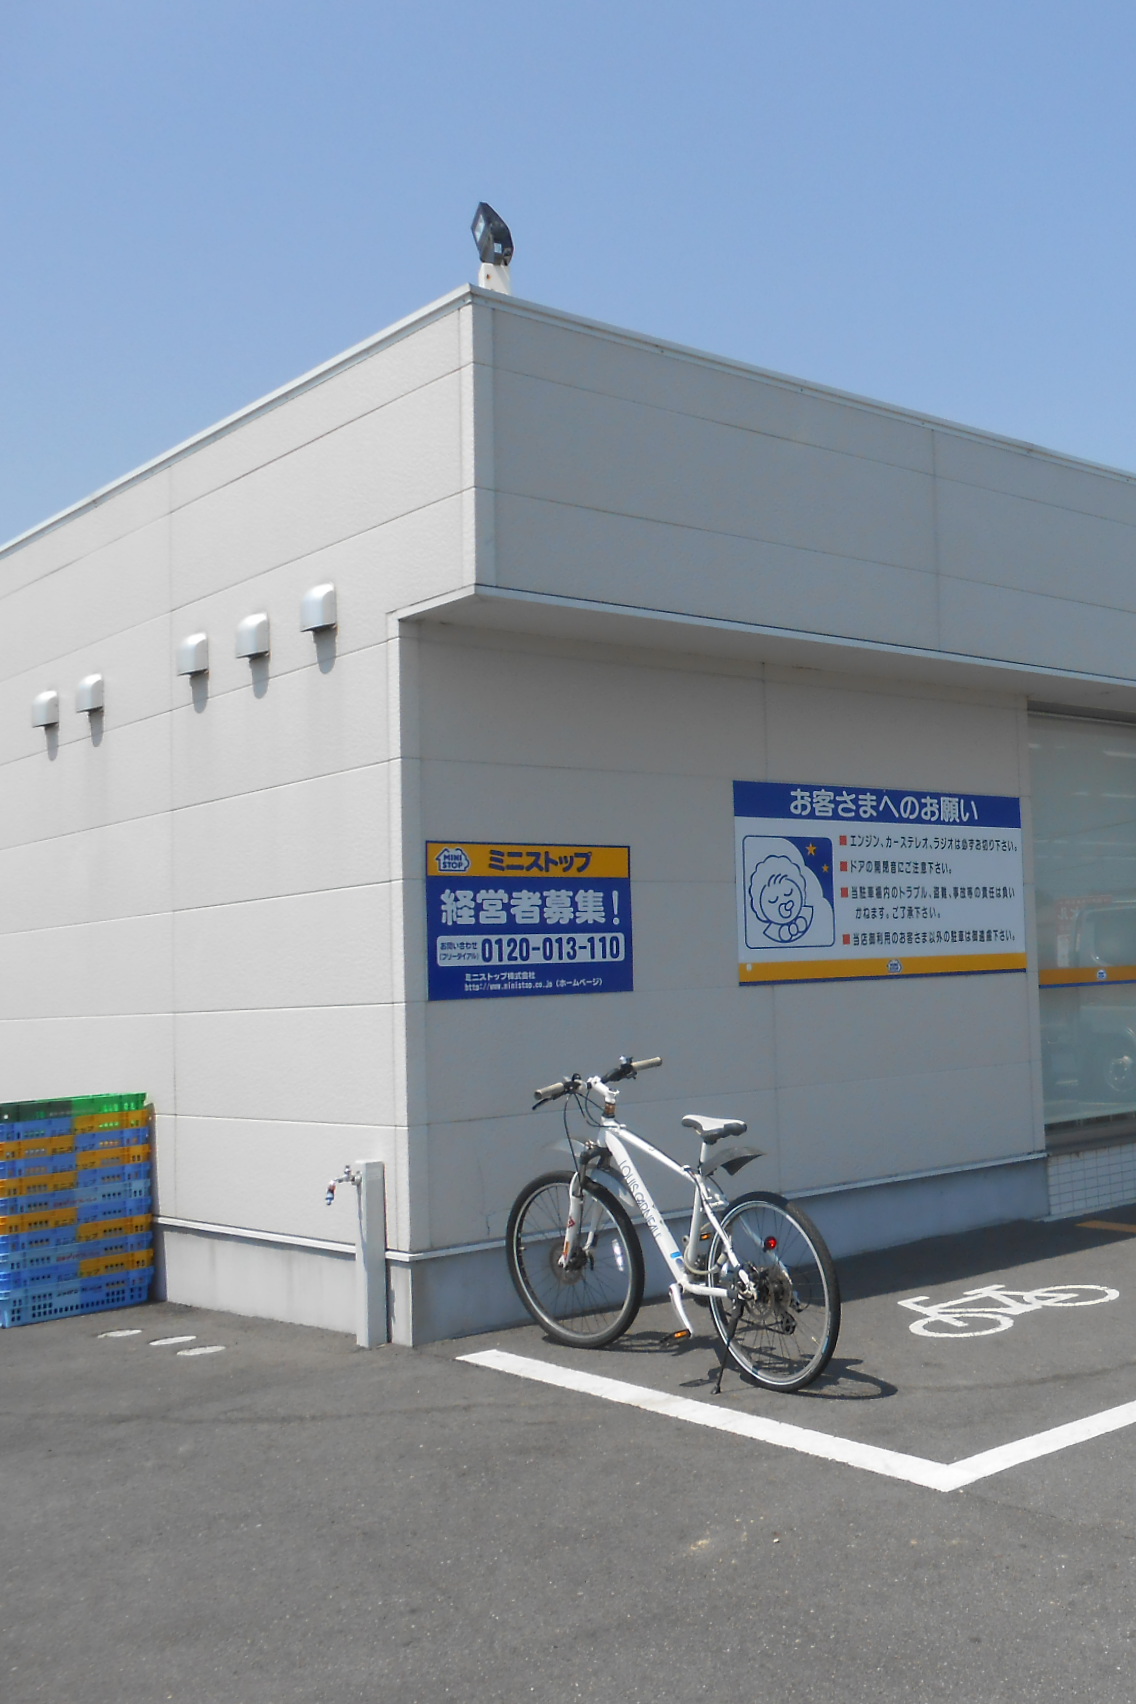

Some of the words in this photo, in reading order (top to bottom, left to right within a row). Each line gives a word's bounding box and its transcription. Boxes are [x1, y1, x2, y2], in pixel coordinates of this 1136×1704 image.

[790, 789, 978, 822] お客さまへのお願い
[442, 861, 463, 869] STOP
[443, 854, 462, 862] MINI
[489, 850, 592, 872] ミニストップ
[481, 936, 620, 962] 0120-013-110
[465, 971, 536, 981] ミニストップ株式会社
[620, 1160, 640, 1194] LOUIS
